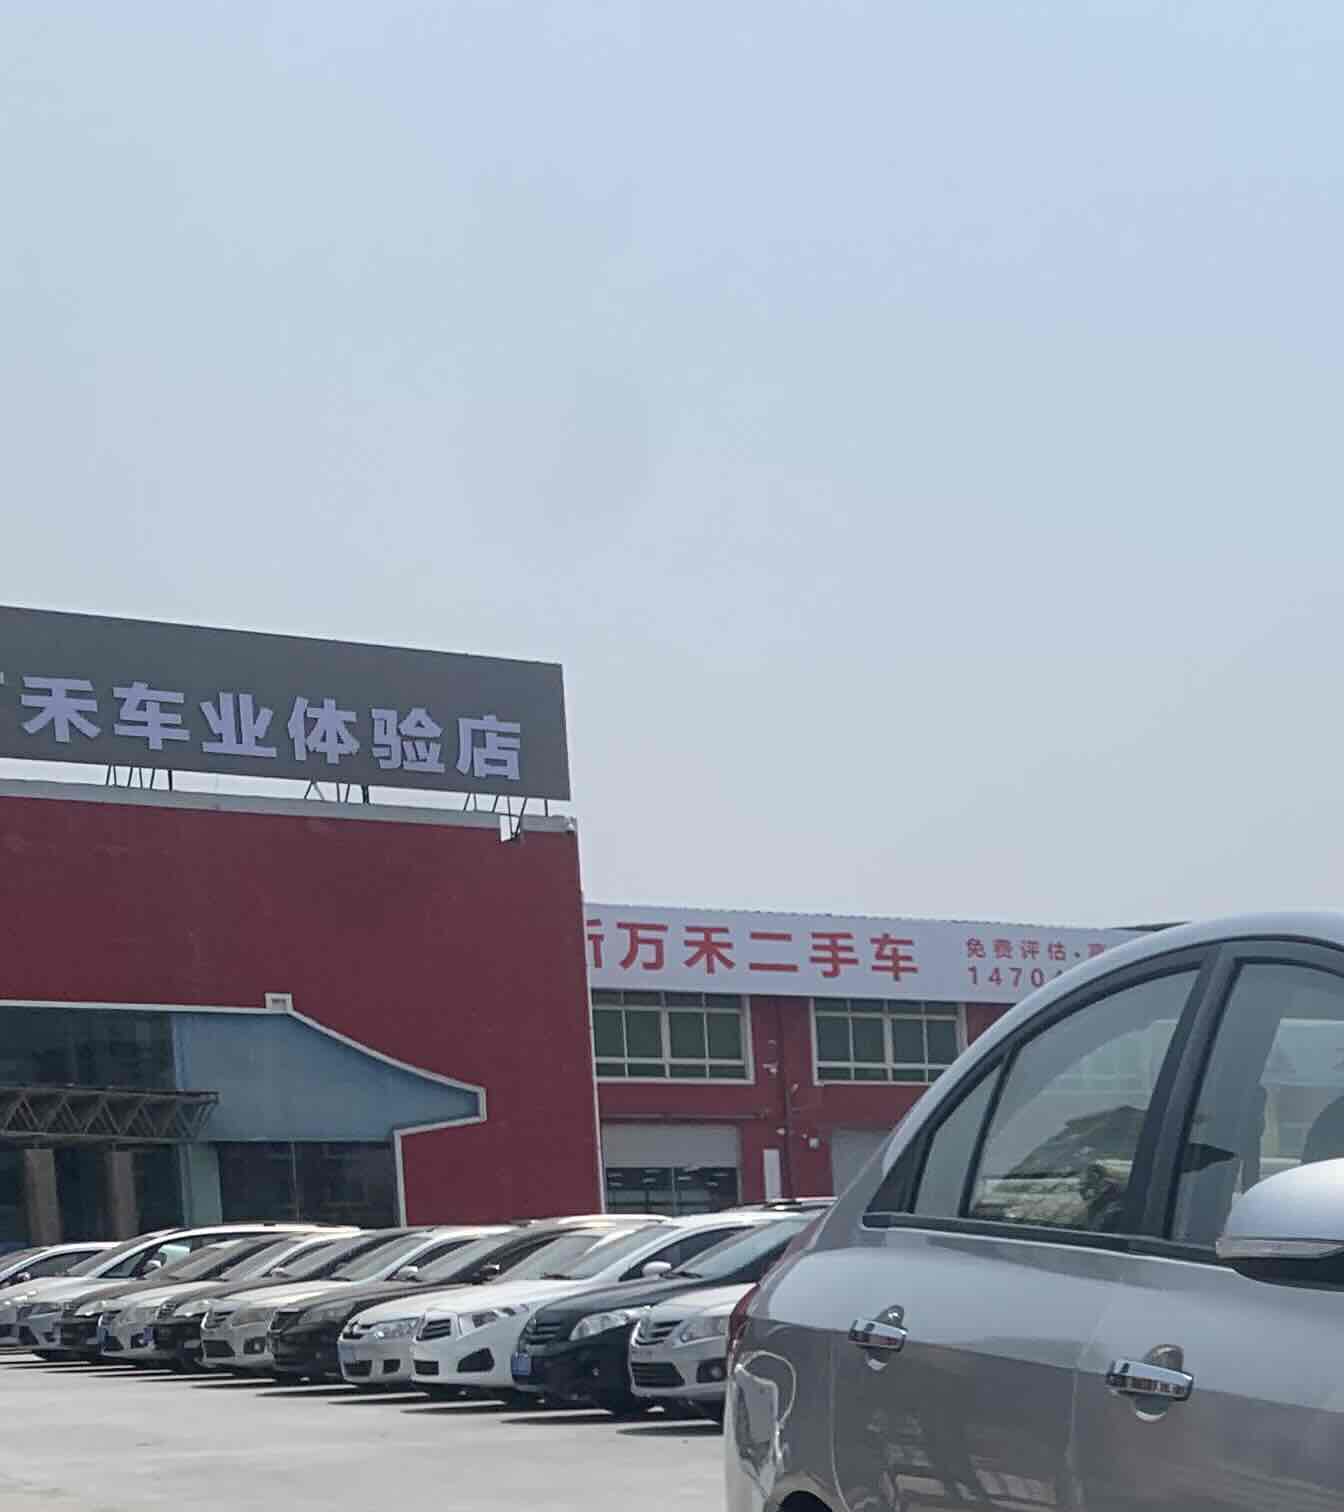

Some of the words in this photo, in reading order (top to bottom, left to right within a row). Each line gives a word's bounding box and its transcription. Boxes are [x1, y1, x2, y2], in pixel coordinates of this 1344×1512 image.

[0, 671, 521, 781] 禾车业体验店
[967, 965, 1063, 989] 1470
